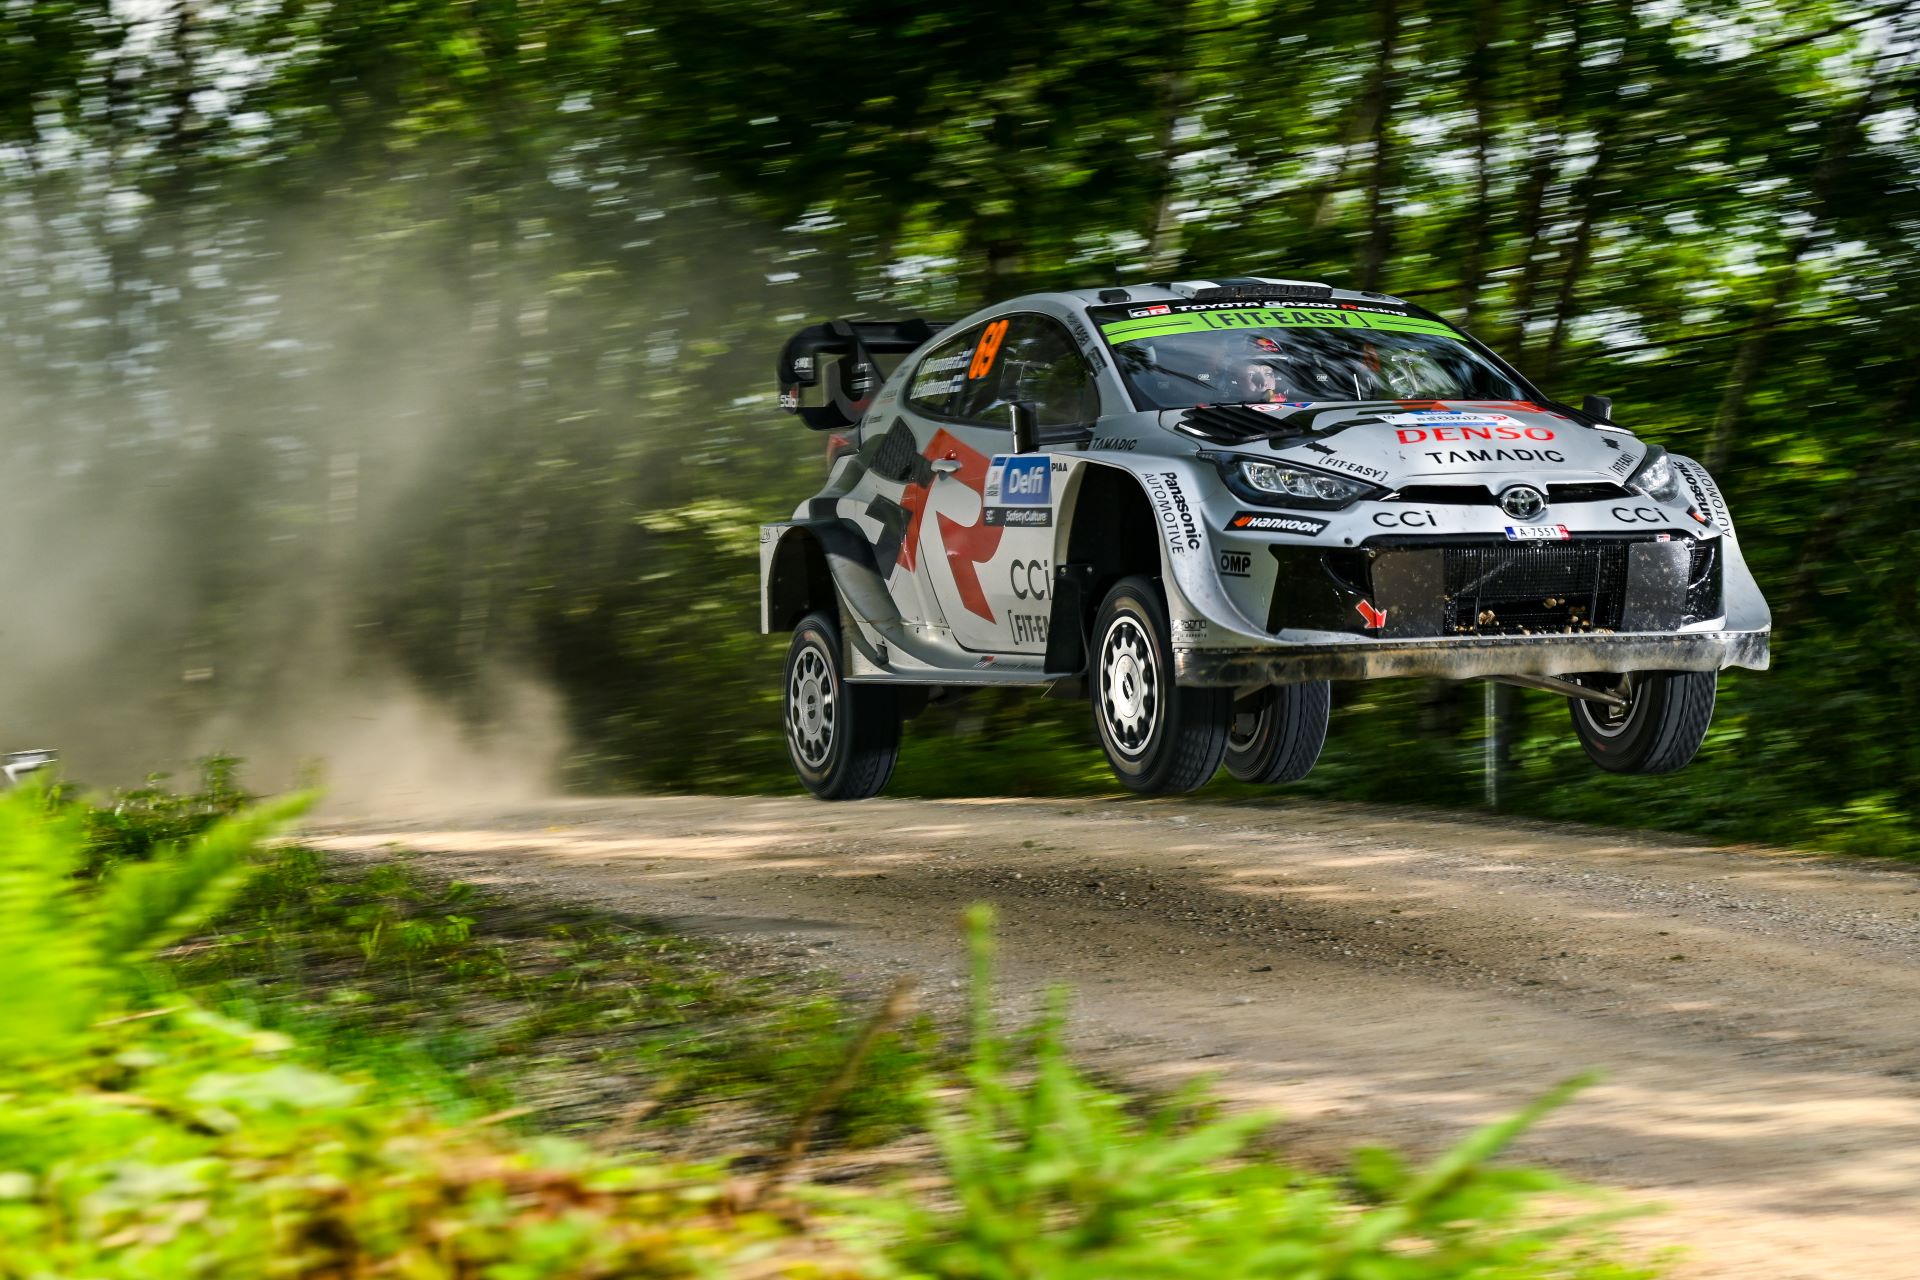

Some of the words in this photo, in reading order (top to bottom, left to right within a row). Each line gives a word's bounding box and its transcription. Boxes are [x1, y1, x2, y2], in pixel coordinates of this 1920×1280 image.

[1175, 300, 1259, 312] TOYOTA
[1263, 300, 1338, 309] GAZOO
[1340, 303, 1408, 317] Racing
[1093, 437, 1137, 451] TAMADIC
[1395, 427, 1556, 445] DENSO
[1425, 449, 1565, 465] TAMADIC
[1008, 466, 1045, 494] Delfi
[1673, 461, 1714, 522] anasonic
[1141, 473, 1185, 556] AUTOMOTIVE
[1160, 472, 1203, 553] Panasonic
[1519, 527, 1558, 537] A-7551
[1220, 552, 1251, 573] OMP
